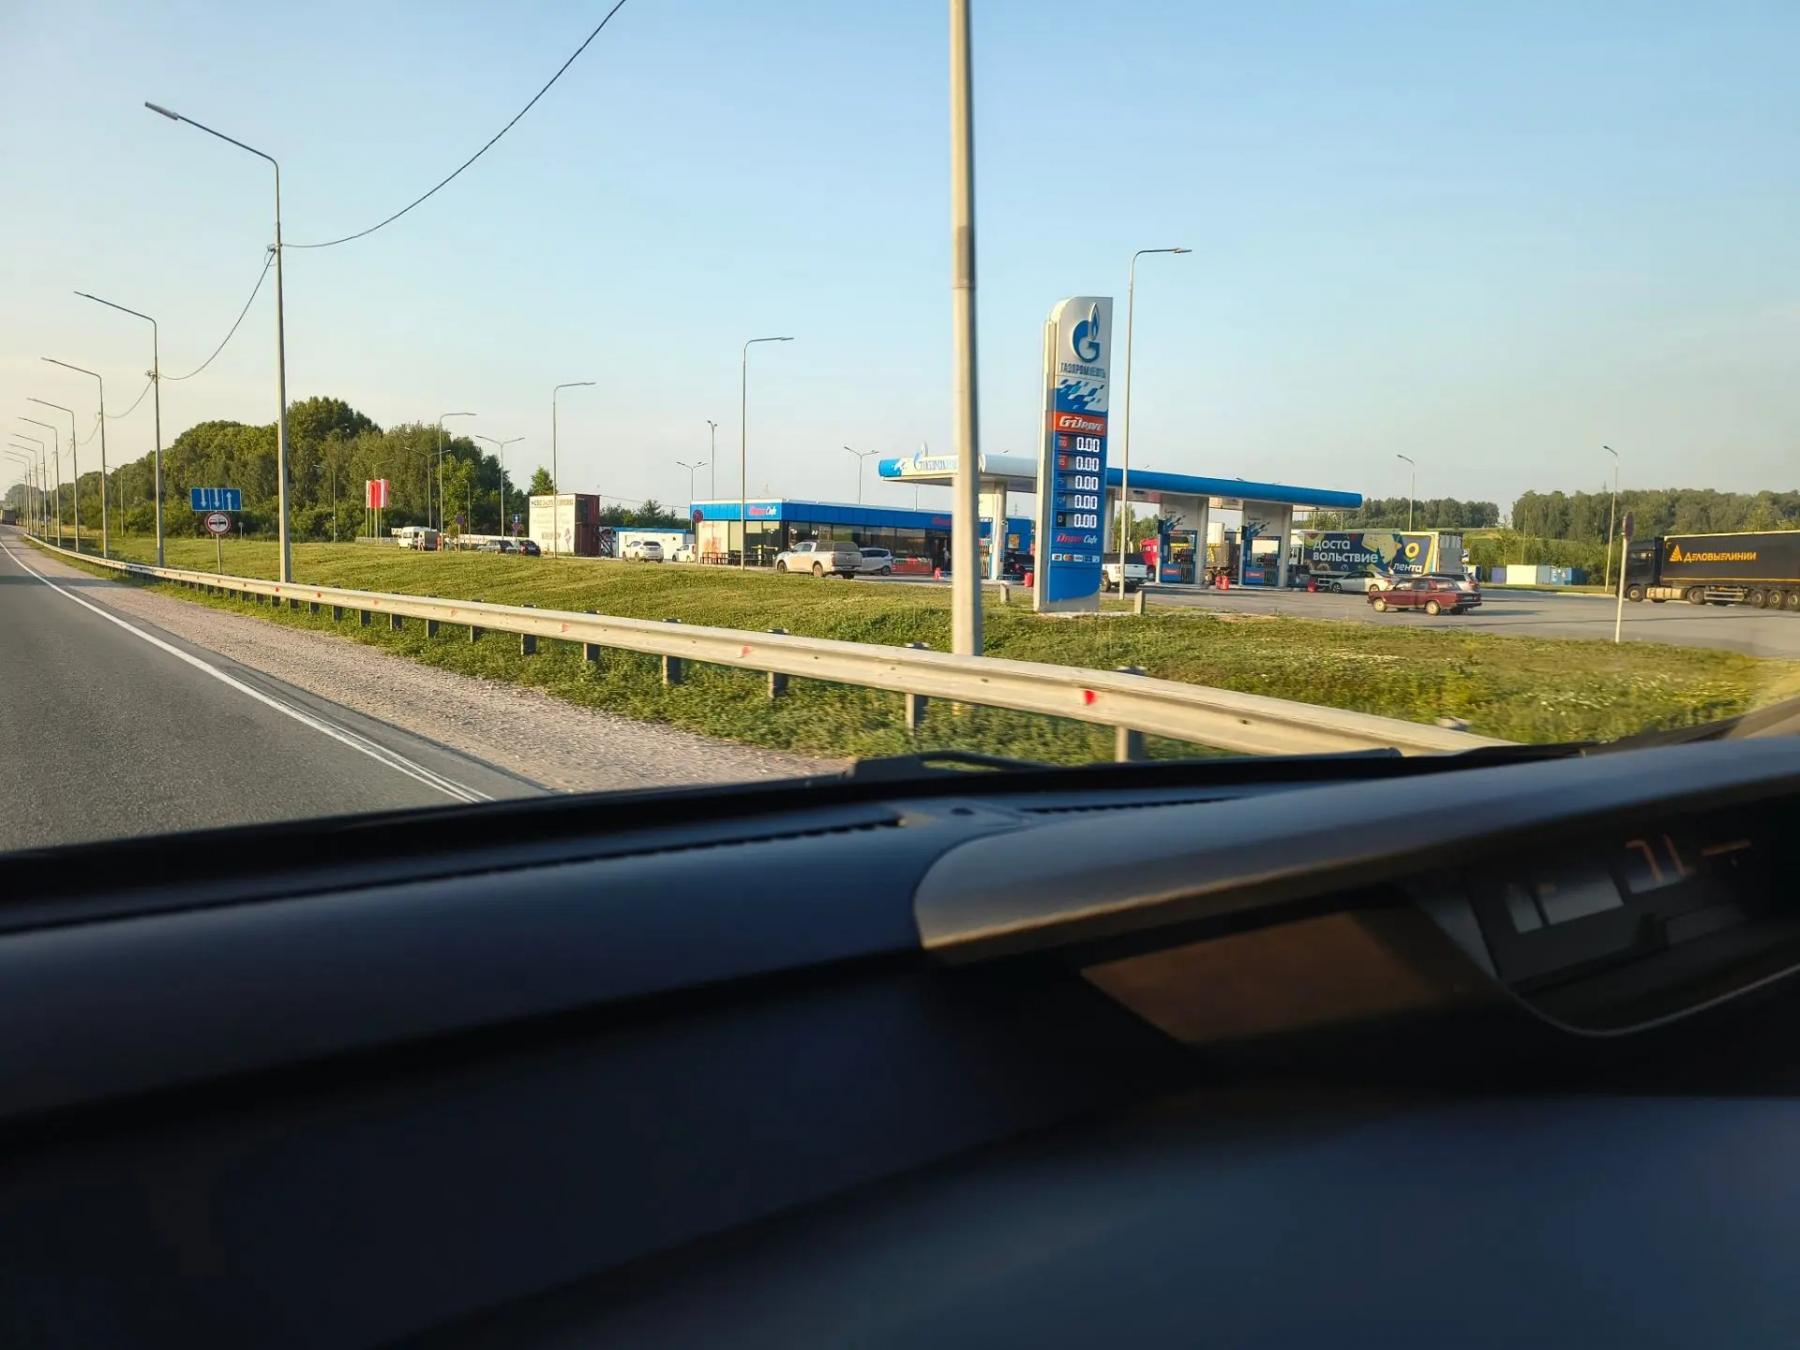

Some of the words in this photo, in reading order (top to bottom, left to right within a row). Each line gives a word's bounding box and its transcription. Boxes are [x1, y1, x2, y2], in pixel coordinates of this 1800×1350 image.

[1076, 436, 1100, 453] 0.00
[1075, 456, 1099, 472] 0.00
[1075, 475, 1099, 490] 0.00
[1074, 494, 1098, 509] 0.00
[1073, 513, 1097, 528] 0.00
